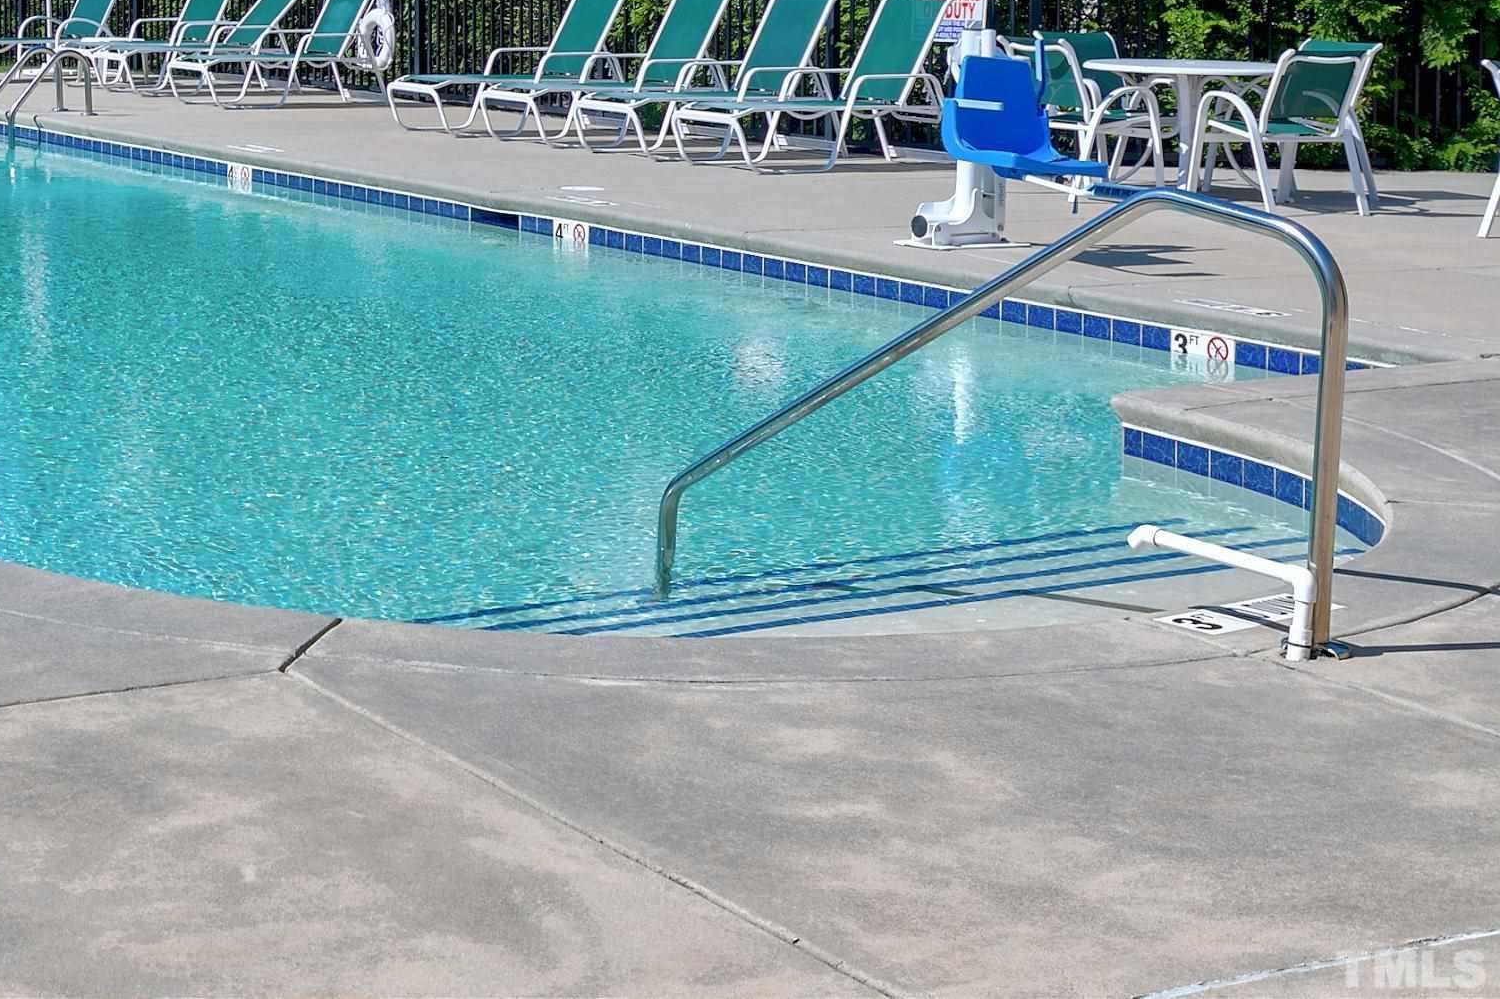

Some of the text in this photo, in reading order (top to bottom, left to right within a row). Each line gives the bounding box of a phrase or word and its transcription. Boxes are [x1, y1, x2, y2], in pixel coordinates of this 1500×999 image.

[945, 2, 976, 19] DUTY
[555, 223, 564, 238] 4
[1174, 333, 1199, 354] 3 FT
